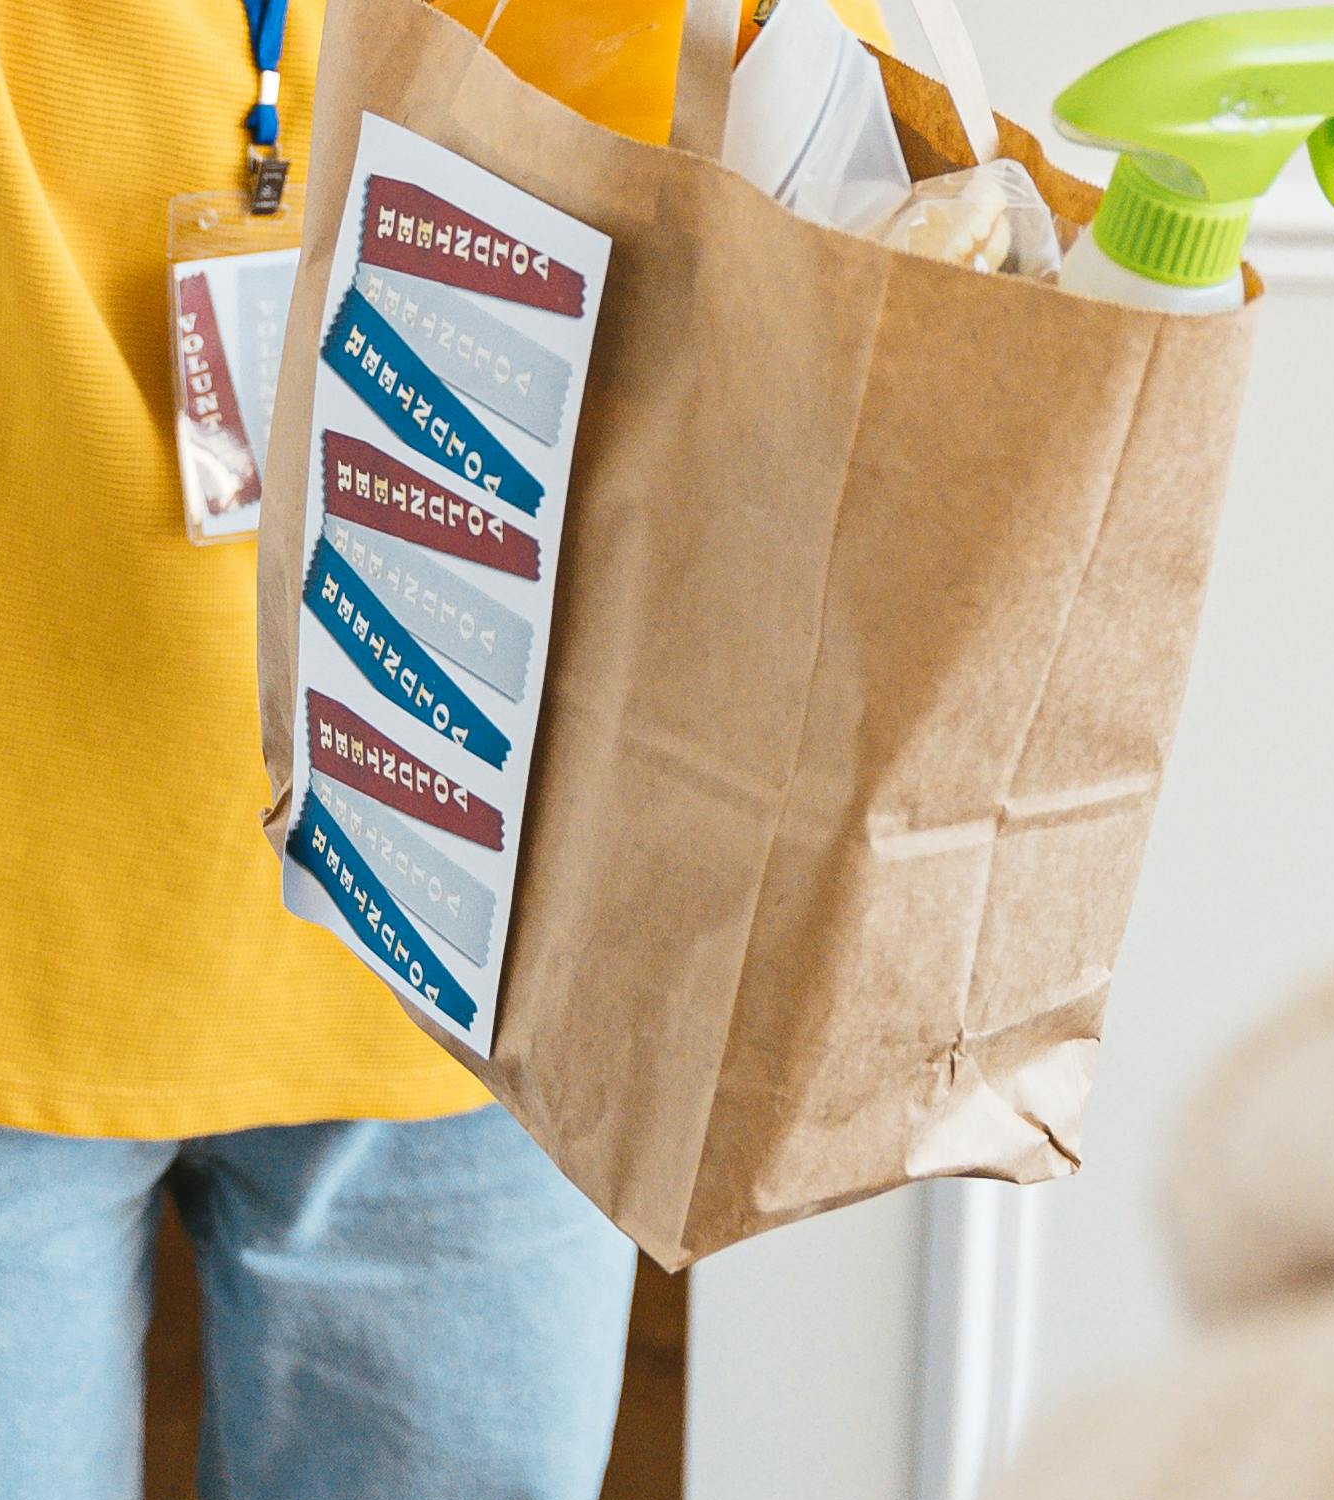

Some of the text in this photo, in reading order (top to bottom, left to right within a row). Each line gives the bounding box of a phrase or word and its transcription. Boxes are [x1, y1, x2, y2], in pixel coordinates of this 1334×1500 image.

[377, 205, 549, 281] VOLUNTEER
[366, 274, 532, 395] VOLUNTEER
[344, 325, 502, 496] VOLUNTEER
[338, 461, 504, 544] VOLUNTEER
[333, 526, 496, 655] VOLUNTEER
[321, 573, 469, 747] VOLUNTEER
[319, 719, 468, 813] VOLUNTEER
[312, 824, 440, 1006] VOLUNTEER
